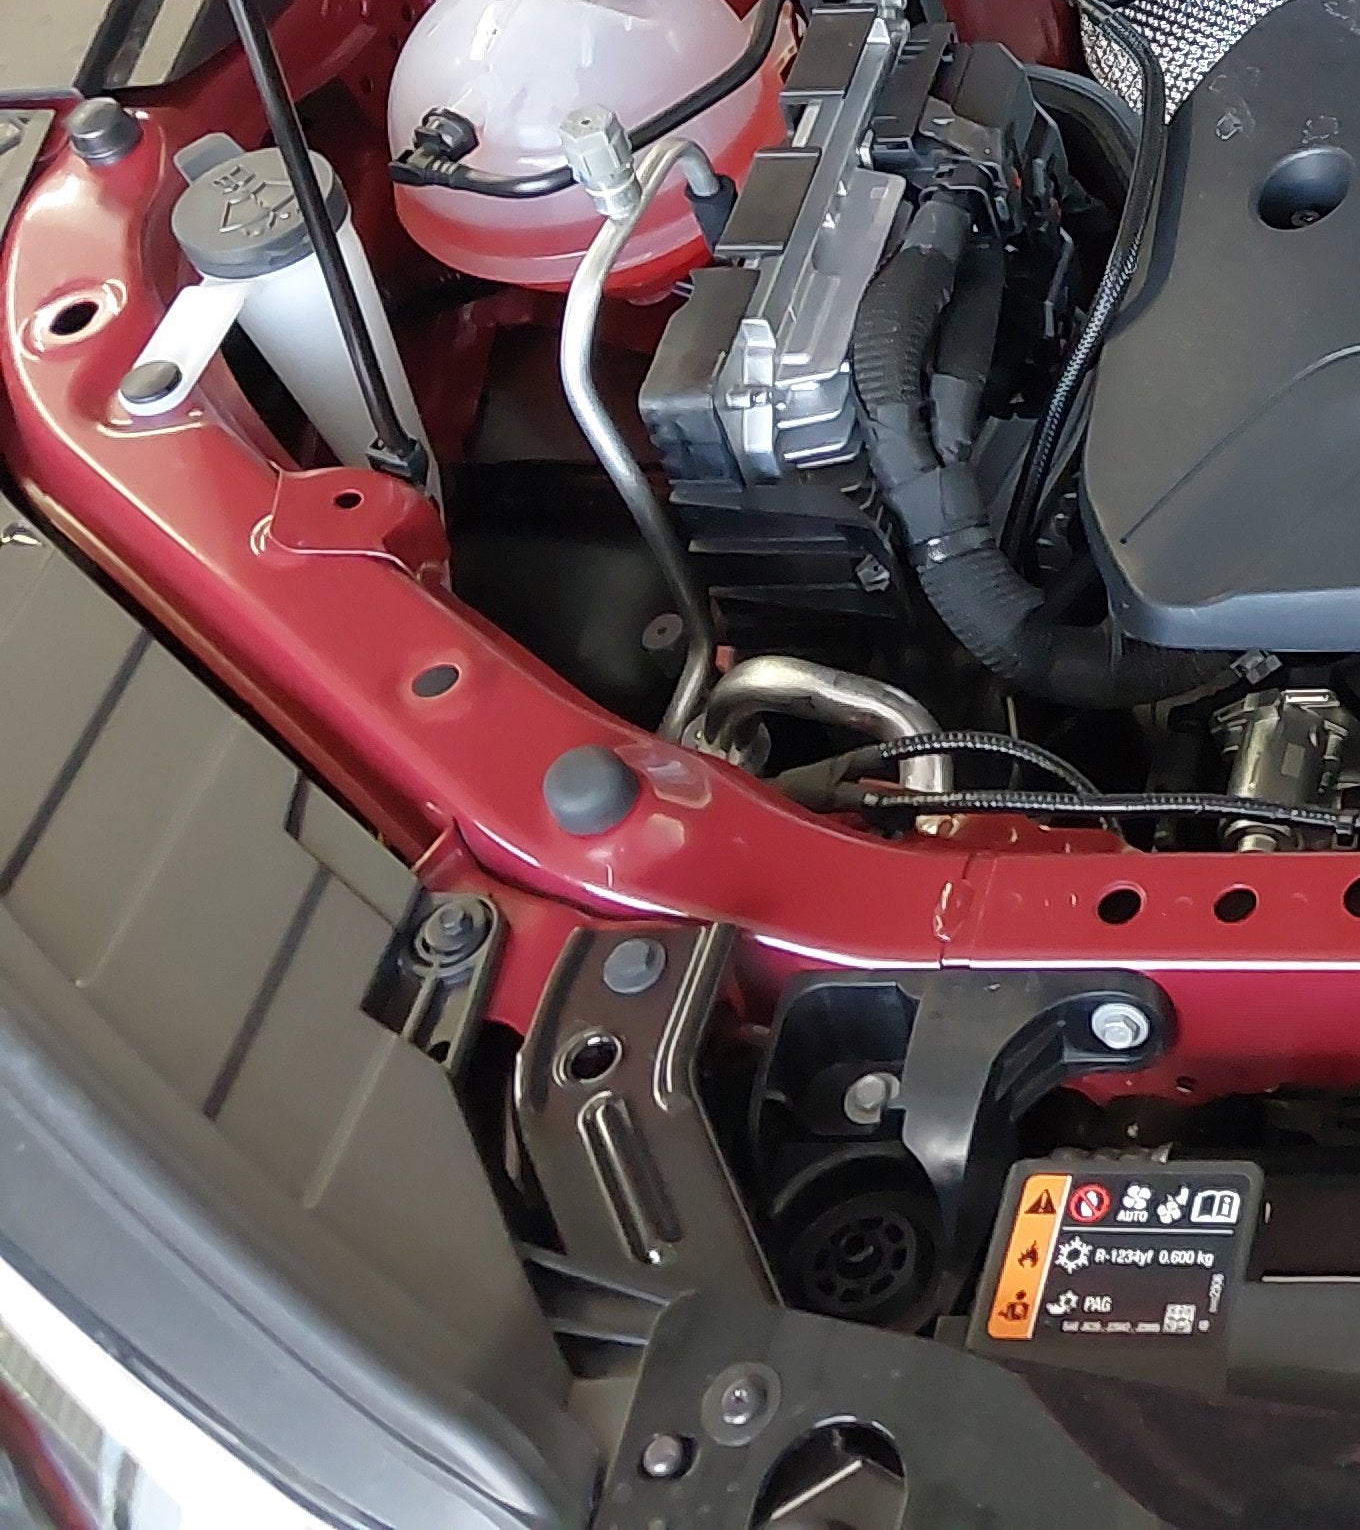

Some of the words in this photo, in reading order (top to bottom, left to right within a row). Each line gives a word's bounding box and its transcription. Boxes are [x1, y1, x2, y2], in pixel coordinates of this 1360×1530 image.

[1116, 1210, 1149, 1222] AUTO
[1158, 1249, 1195, 1264] 0.600
[1196, 1250, 1214, 1268] kg
[1083, 1296, 1113, 1312] PAG
